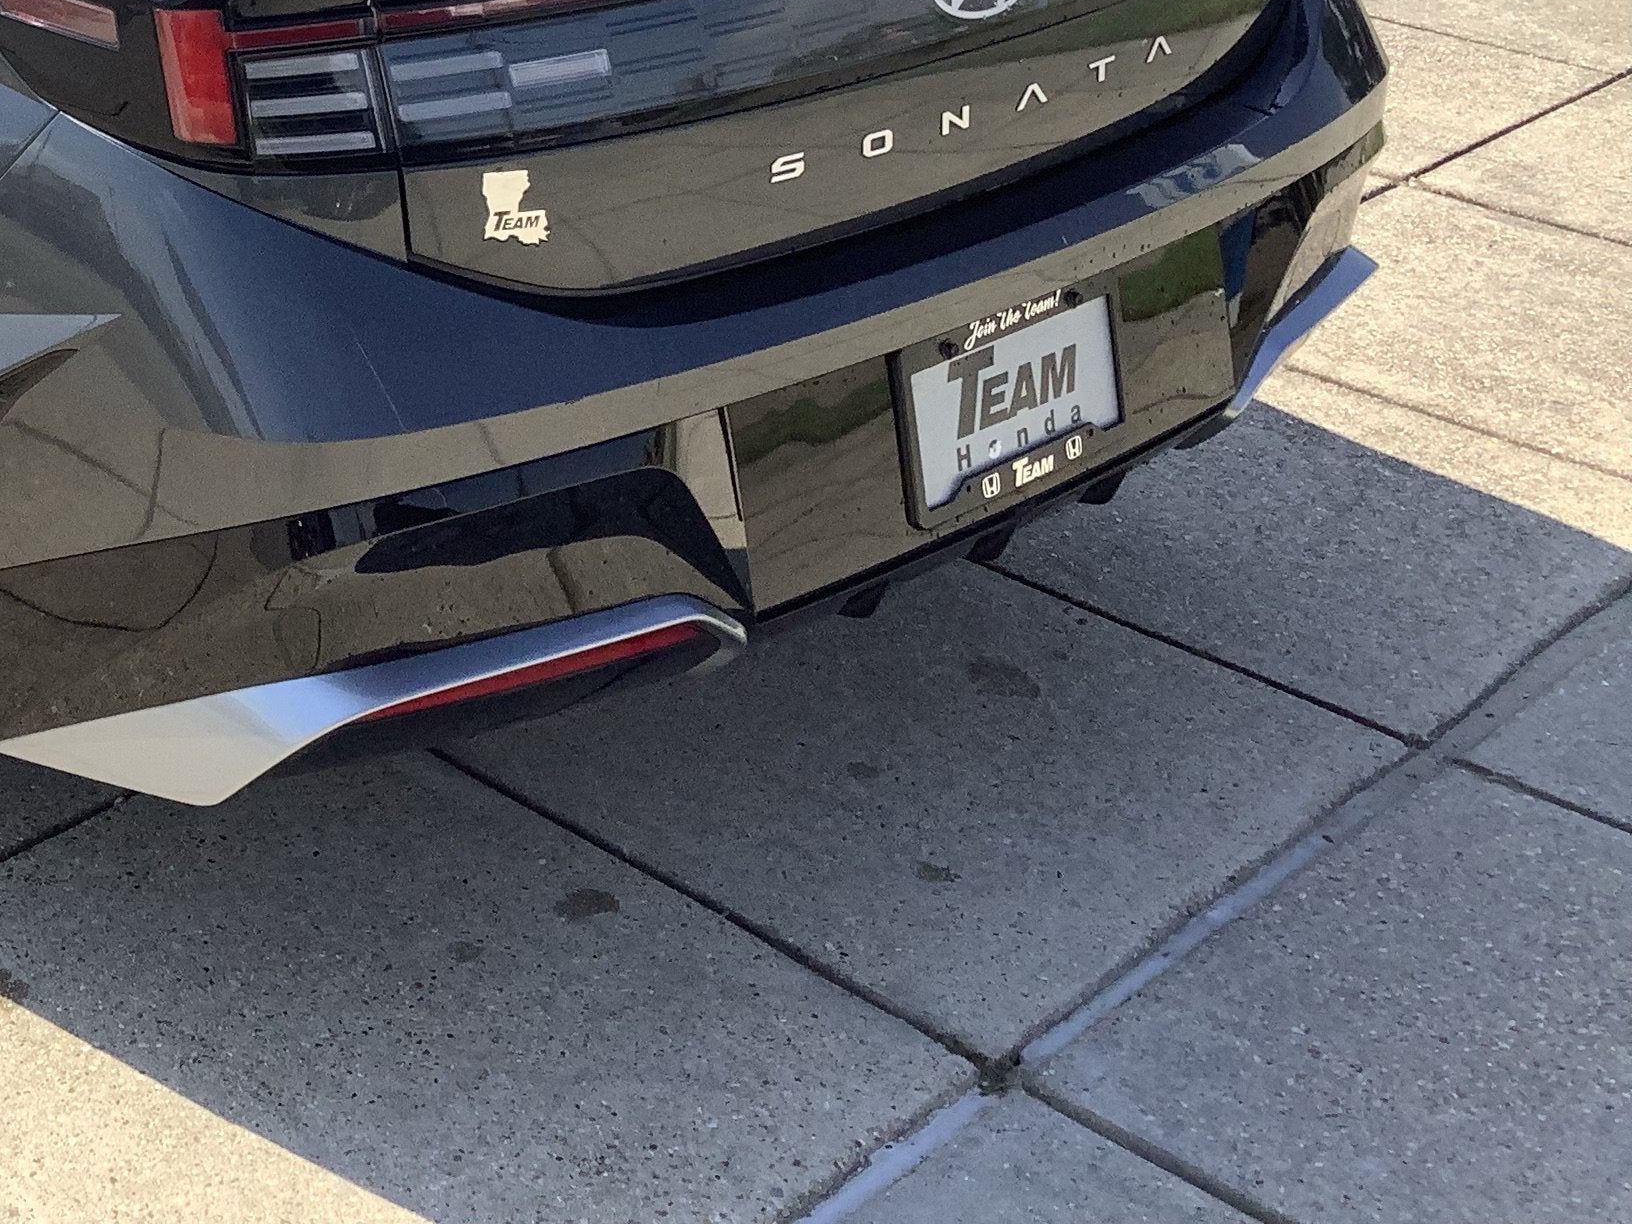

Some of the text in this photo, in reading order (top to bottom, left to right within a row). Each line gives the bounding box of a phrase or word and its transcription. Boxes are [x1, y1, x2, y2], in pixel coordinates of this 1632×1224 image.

[770, 35, 1172, 184] SONATA
[493, 210, 541, 232] TEAM
[963, 317, 997, 351] Join
[947, 344, 1077, 440] TEAM
[1012, 454, 1055, 488] TEAM
